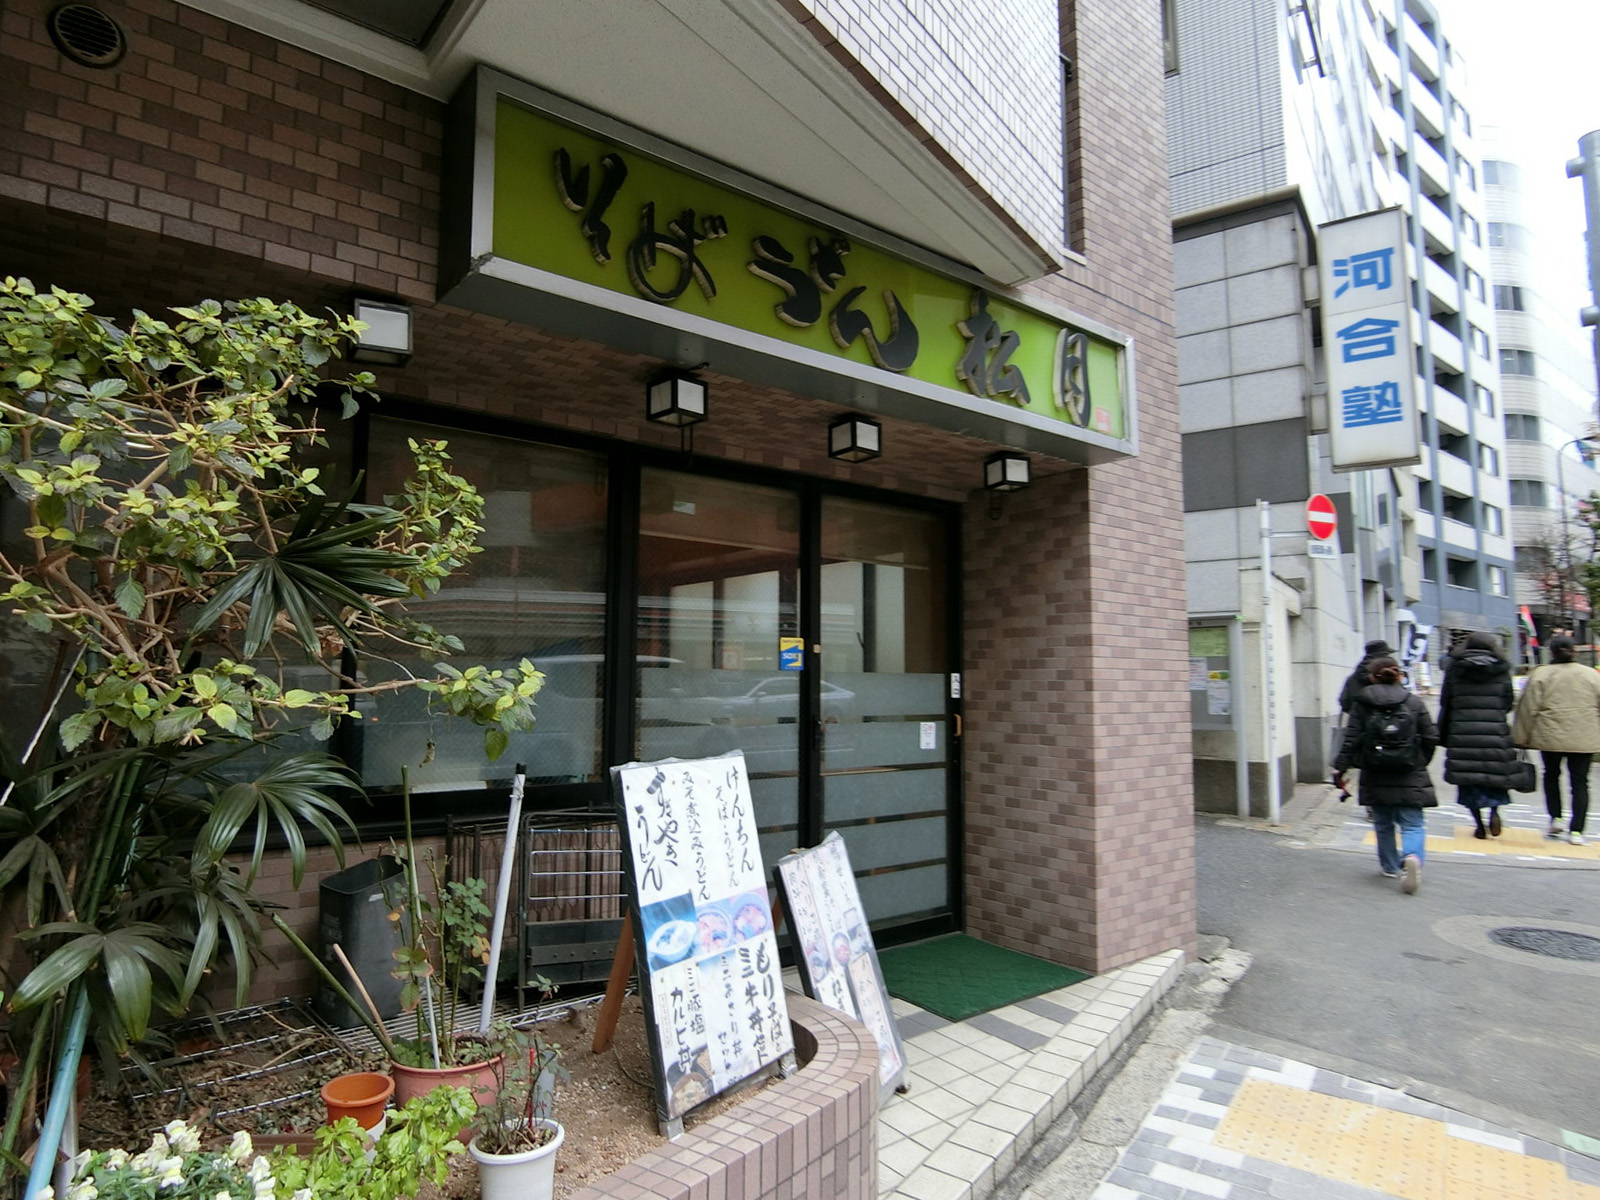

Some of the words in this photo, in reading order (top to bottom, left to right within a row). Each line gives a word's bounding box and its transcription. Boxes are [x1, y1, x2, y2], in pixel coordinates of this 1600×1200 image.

[955, 290, 1092, 428] 松月
[1331, 246, 1404, 429] 河合塾
[725, 765, 755, 874] けんちん
